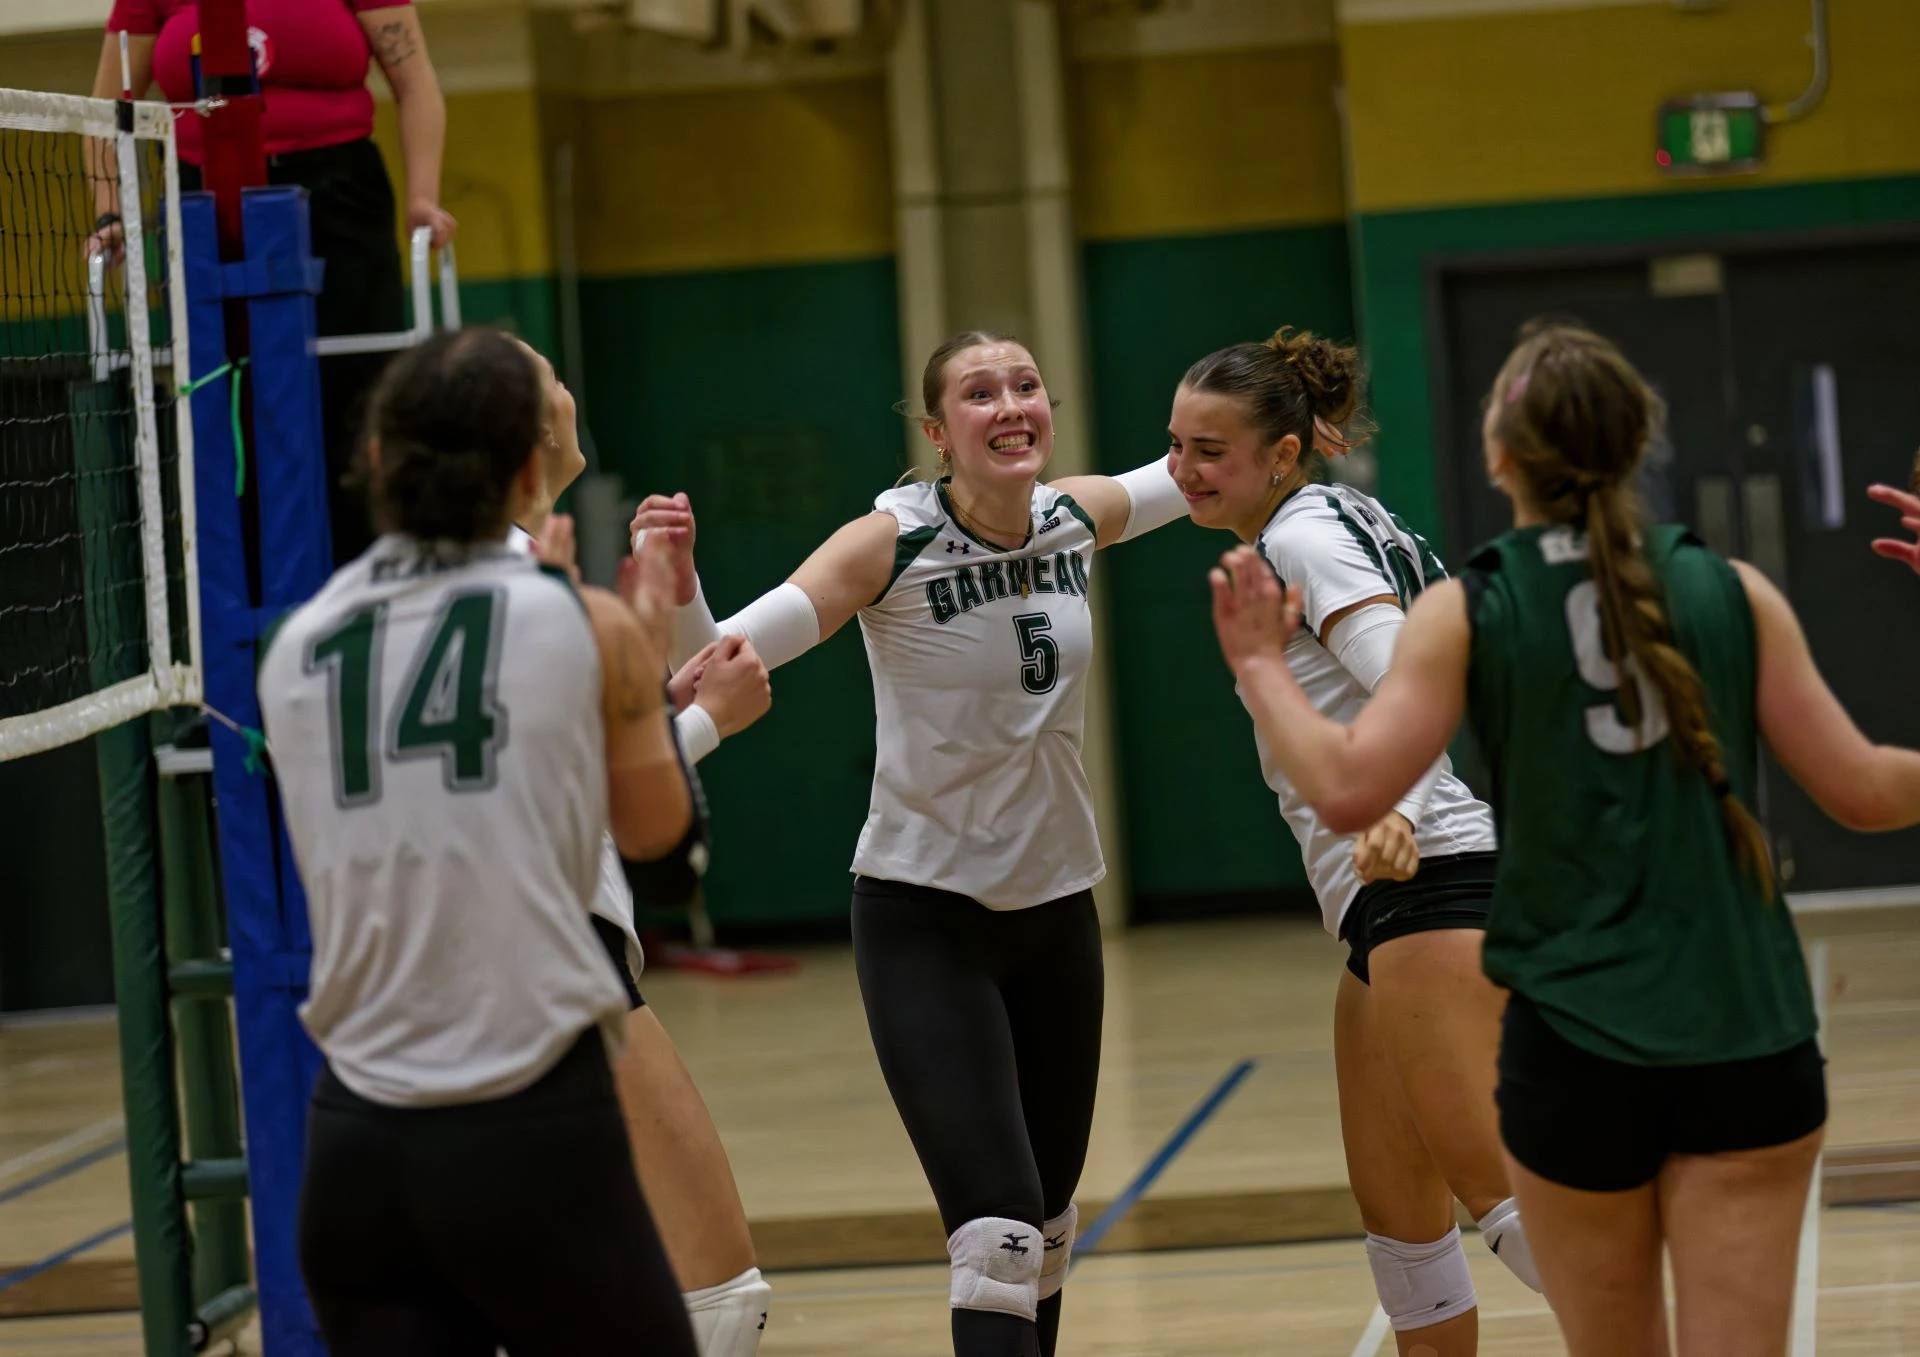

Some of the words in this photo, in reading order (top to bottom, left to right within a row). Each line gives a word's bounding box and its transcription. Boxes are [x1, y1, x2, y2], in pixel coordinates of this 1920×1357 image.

[302, 585, 510, 810] 14
[1012, 612, 1059, 695] 5
[1565, 580, 1670, 755] 9
